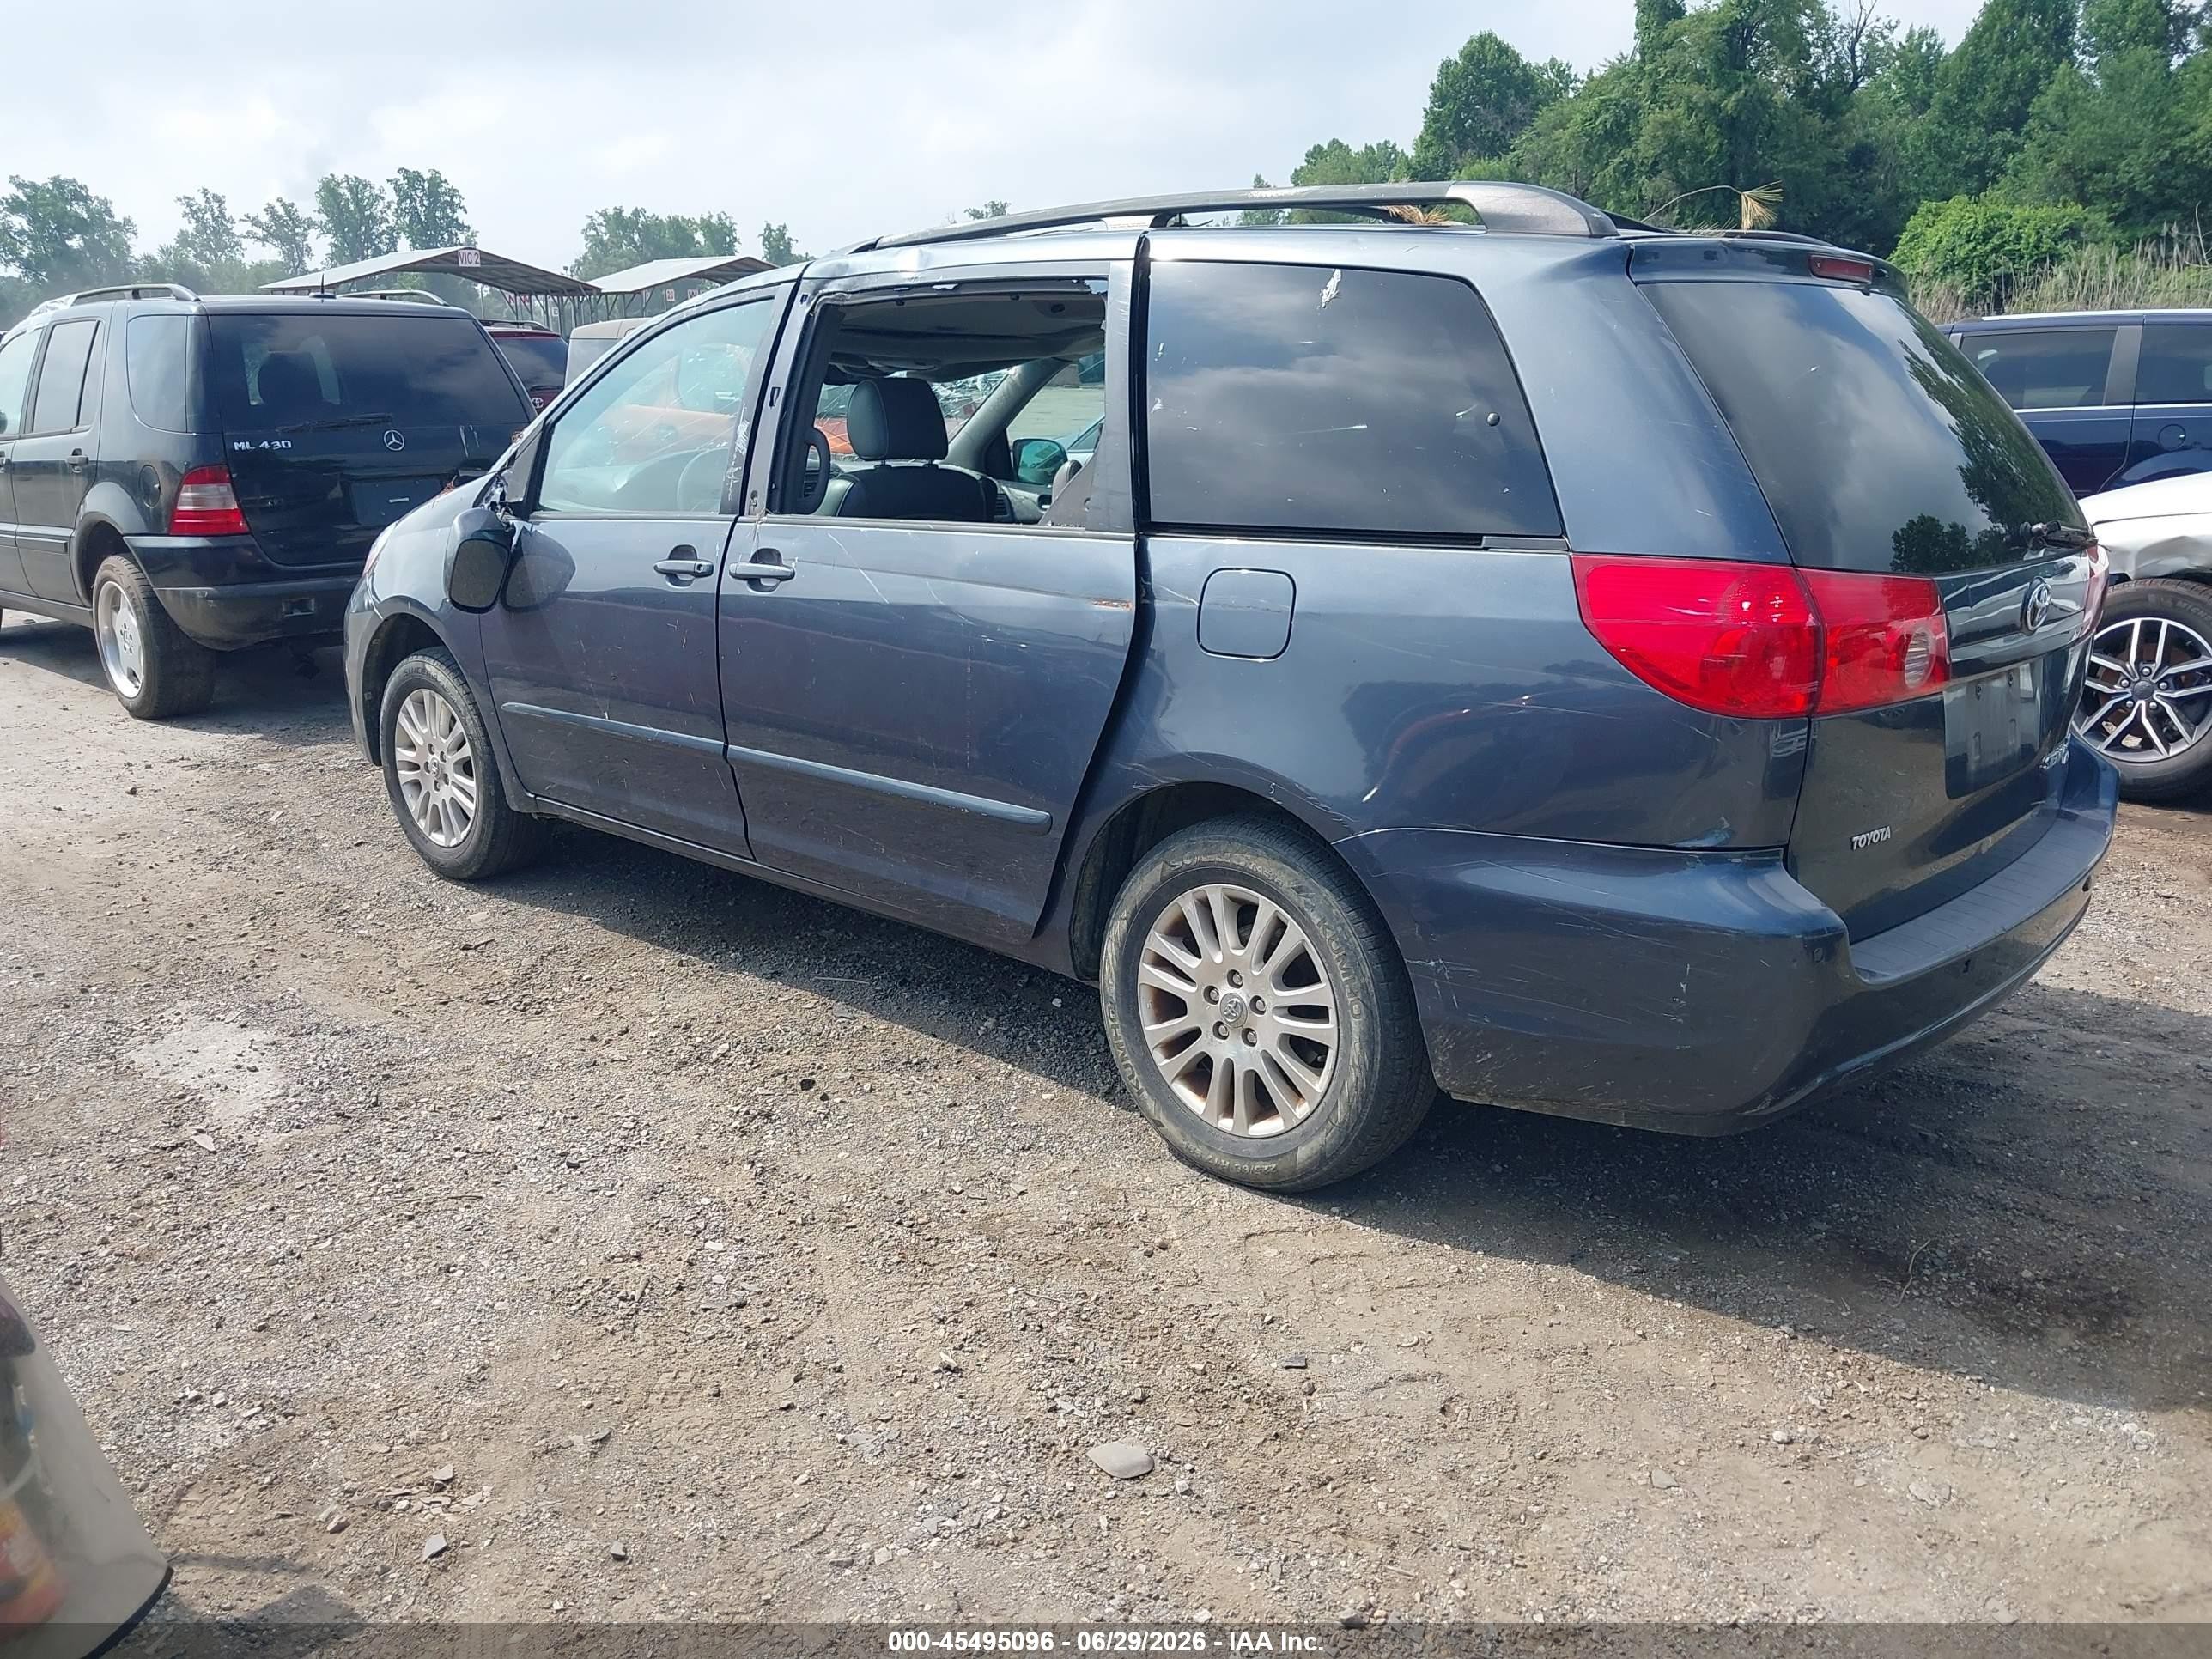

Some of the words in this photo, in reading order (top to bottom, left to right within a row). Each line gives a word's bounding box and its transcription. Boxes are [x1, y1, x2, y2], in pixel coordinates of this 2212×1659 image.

[459, 252, 472, 265] VIC
[473, 252, 480, 265] 2
[234, 441, 256, 451] ML
[258, 440, 292, 450] 430
[1850, 825, 1892, 851] TOYOTA
[1316, 916, 1363, 1020] KUMHO
[1107, 1001, 1146, 1097] KUMHO
